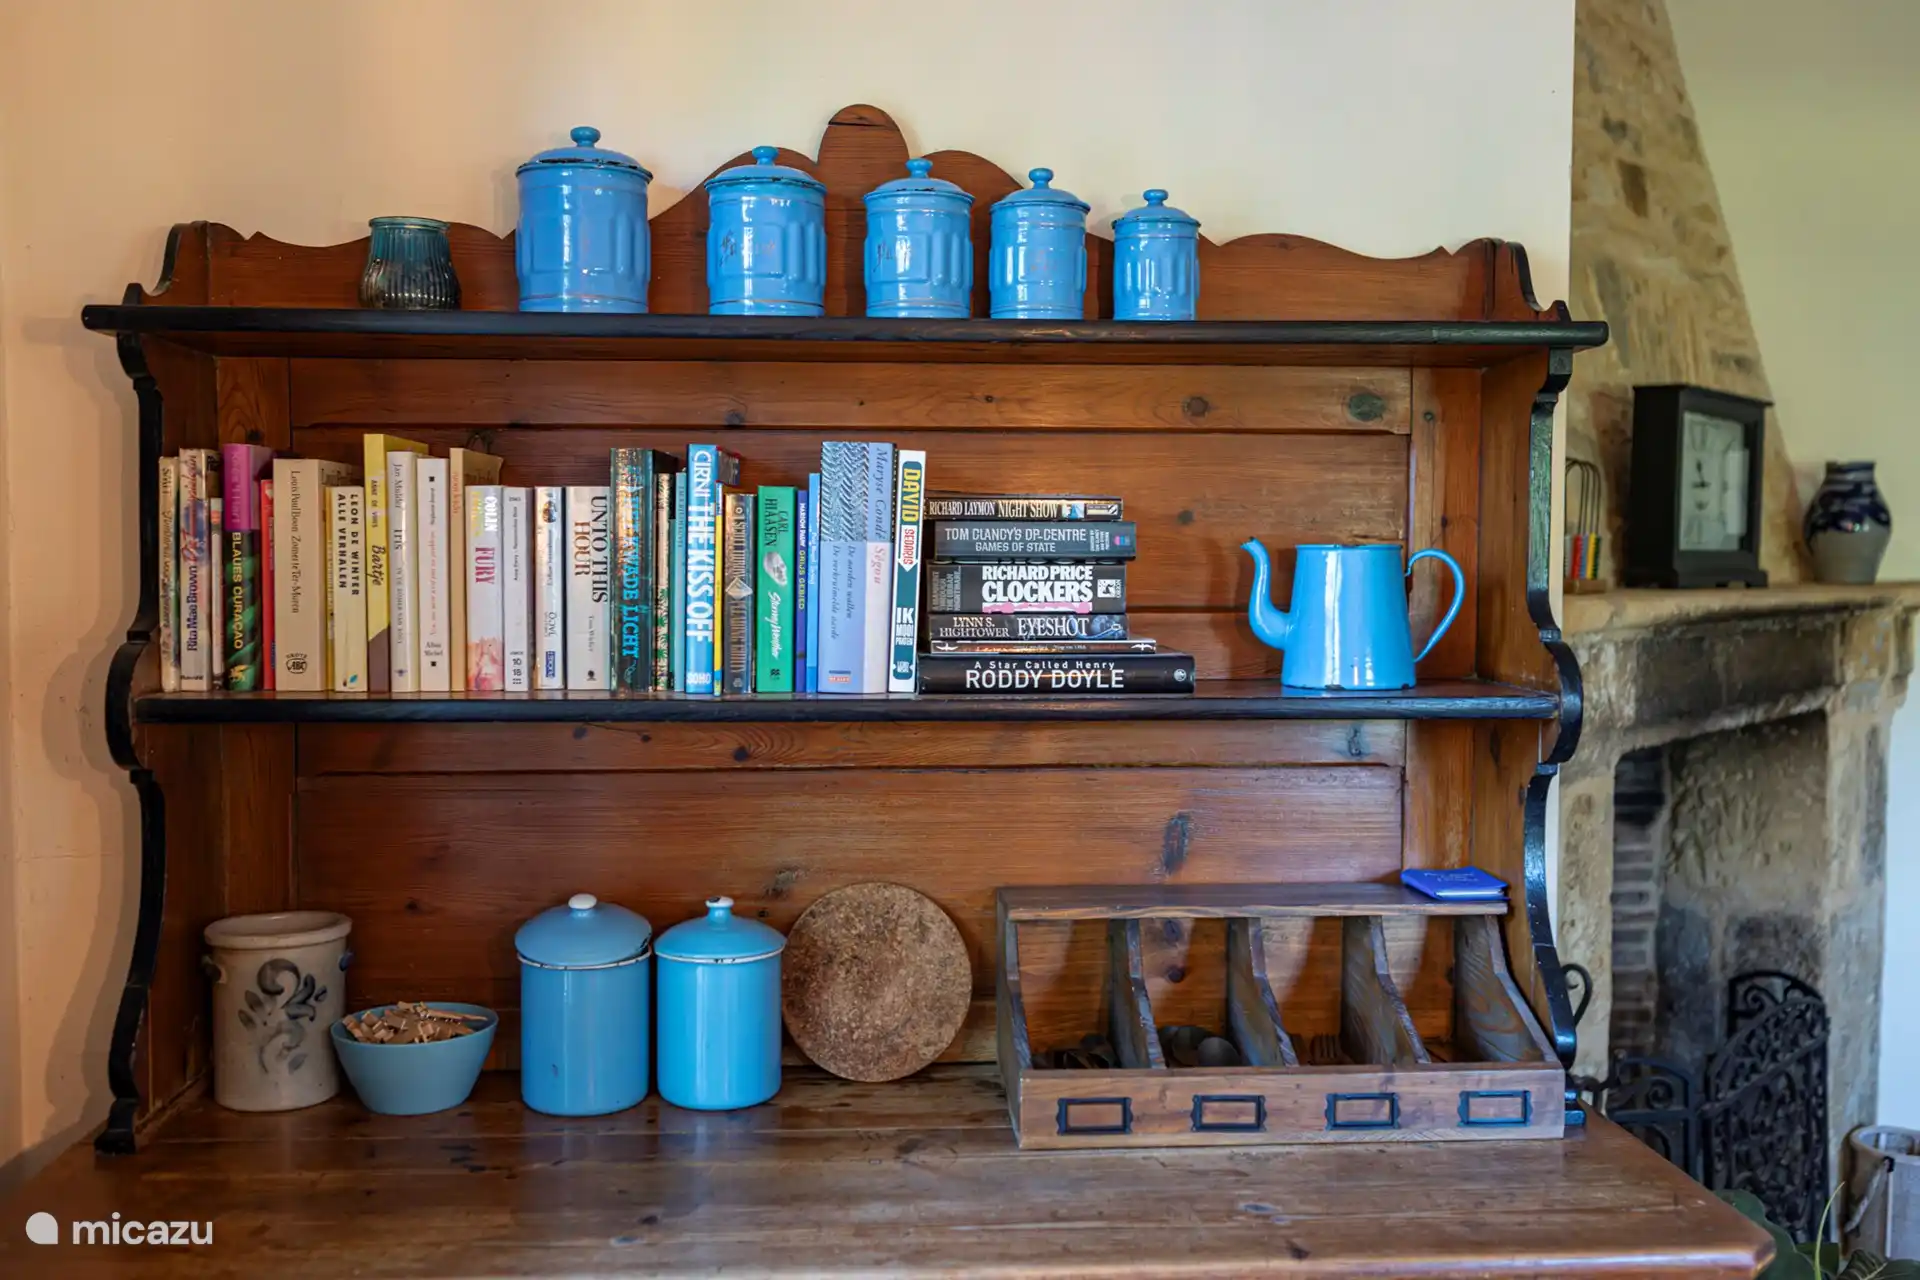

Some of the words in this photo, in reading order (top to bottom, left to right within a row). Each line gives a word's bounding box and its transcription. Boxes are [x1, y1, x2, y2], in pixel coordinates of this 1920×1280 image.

[290, 470, 301, 493] Louis
[394, 463, 403, 479] Jan
[694, 450, 711, 498] CIRNI
[872, 448, 888, 494] Maryse
[290, 493, 301, 511] Paul
[338, 494, 346, 522] ALLE
[394, 479, 403, 509] Mulder
[902, 468, 921, 522] DAVID
[929, 501, 963, 516] RICHARD
[964, 501, 996, 516] LAYMON
[998, 499, 1029, 518] NIGHT
[1029, 500, 1059, 518] SHOW
[290, 511, 301, 532] Boon
[350, 494, 359, 525] LEON
[485, 496, 498, 532] COLIN
[591, 495, 608, 552] UNTO
[688, 502, 715, 544] THE
[764, 498, 778, 547] HIAASEN
[778, 510, 789, 534] CARL
[874, 499, 888, 540] Condé
[350, 531, 359, 545] DE
[574, 521, 591, 576] HOUR
[902, 528, 915, 565] SEDARIS
[944, 528, 969, 541] TOM
[972, 526, 1022, 541] CLANCY'S
[975, 542, 1009, 552] GAMES
[1012, 542, 1025, 552] OF
[1026, 542, 1056, 552] STATE
[231, 531, 243, 582] BLAUES
[338, 528, 347, 589] VERHALEN
[364, 545, 386, 586] Bartje
[474, 547, 496, 584] FURY
[832, 545, 840, 557] De
[848, 545, 856, 557] De
[350, 551, 359, 596] WINTER
[591, 556, 609, 603] THIS
[622, 536, 640, 600] KWADE
[687, 549, 714, 598] KISS
[847, 559, 856, 589] aarden
[982, 566, 1050, 580] RICHARD
[1051, 566, 1093, 580] PRICE
[186, 566, 198, 604] Brown
[831, 560, 840, 614] verkruimelde
[982, 581, 1093, 603] CLOCKERS
[186, 605, 198, 629] Mae
[232, 586, 245, 649] CURAÇAO
[846, 591, 855, 620] wallen
[895, 607, 914, 624] IK
[548, 612, 557, 636] JACQ
[622, 605, 640, 658] LICHT
[686, 601, 713, 642] OFF
[939, 627, 1010, 638] HIGHTOWER
[953, 617, 984, 627] LYNN
[985, 617, 996, 627] S.
[1016, 616, 1090, 638] EYESHOT
[186, 630, 198, 651] Rita
[687, 672, 711, 685] SOHO
[965, 670, 1043, 688] RODDY
[1051, 670, 1124, 688] DOYLE
[974, 661, 982, 669] A
[989, 661, 1017, 669] Star
[1025, 661, 1068, 669] Called
[1076, 661, 1115, 670] Henry
